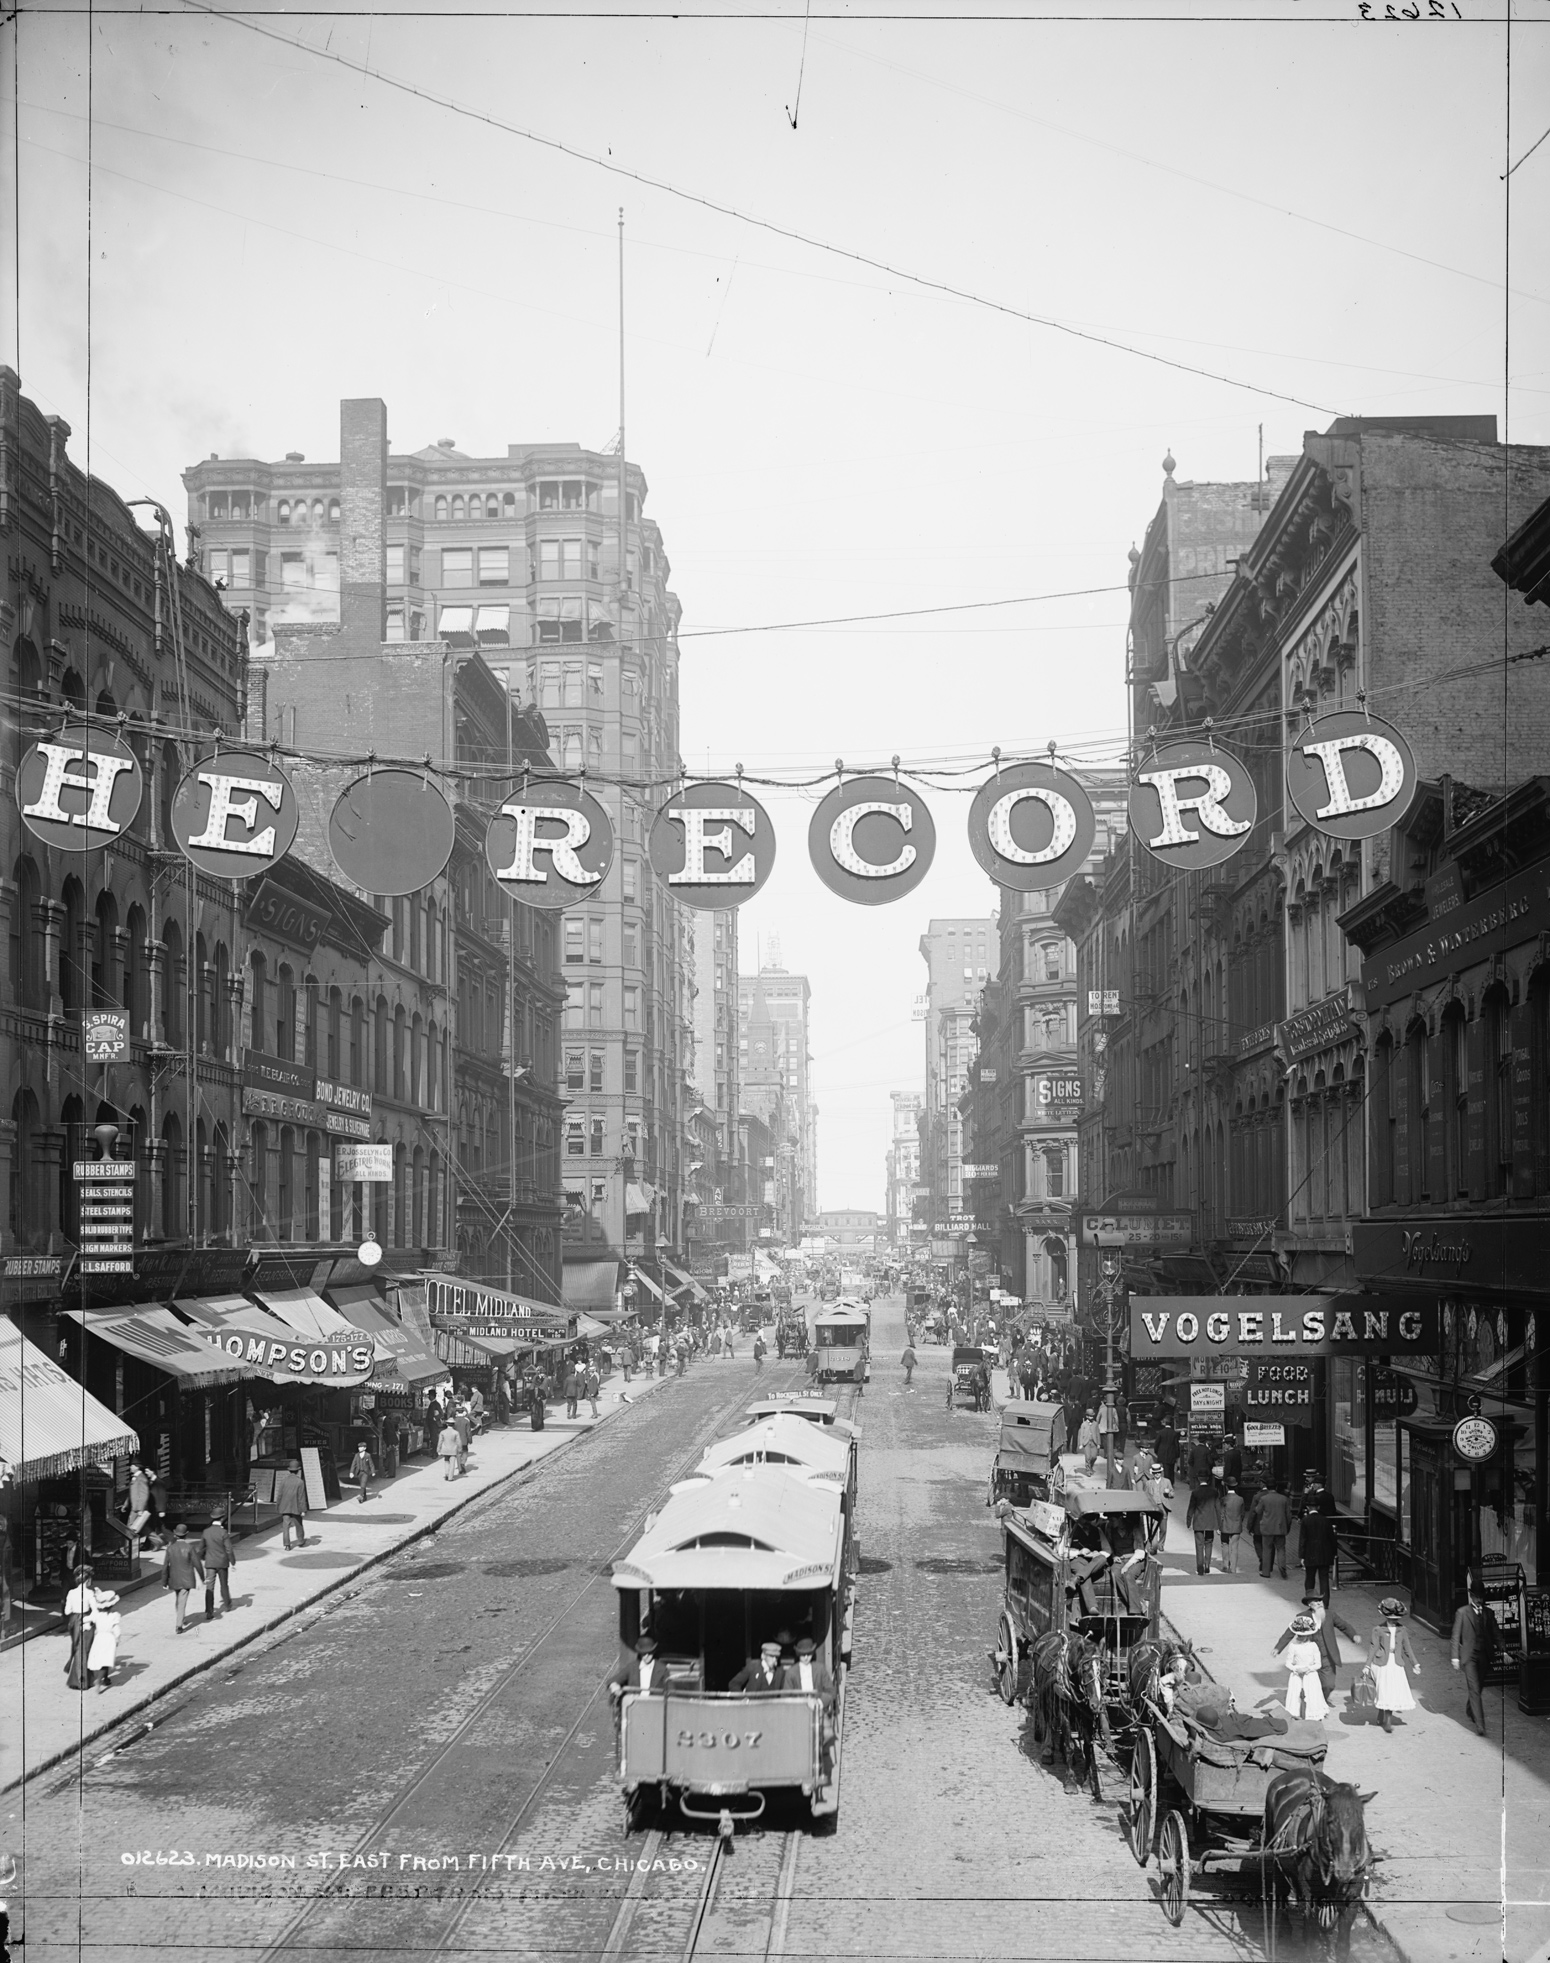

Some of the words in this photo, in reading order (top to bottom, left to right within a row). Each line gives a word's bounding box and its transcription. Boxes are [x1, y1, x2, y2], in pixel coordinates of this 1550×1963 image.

[1432, 894, 1461, 920] JEWELERS
[1386, 953, 1423, 985] BROWN
[1438, 896, 1530, 957] WINTERBERG
[92, 1013, 125, 1030] SPIRA
[85, 1041, 125, 1053] CAP
[1038, 1080, 1081, 1104] SIGNS
[75, 1164, 105, 1177] RUBBER
[107, 1164, 134, 1177] STAMPS
[103, 1188, 133, 1197] STENCILS
[81, 1206, 104, 1217] STEEL
[104, 1206, 131, 1217] STAMPS
[699, 1207, 760, 1217] BREVOORT
[97, 1225, 119, 1234] RUBBER
[119, 1225, 133, 1234] TYPE
[934, 1222, 970, 1231] BILLIARD
[971, 1222, 992, 1231] HALL
[80, 1243, 99, 1253] SIGN
[100, 1243, 133, 1253] MARKERS
[425, 1278, 471, 1317] OTEL
[476, 1292, 532, 1319] MIDLAND
[469, 1326, 508, 1337] MIDLAND
[510, 1328, 545, 1338] HOTEL
[1140, 1311, 1423, 1343] VOGELSANG
[331, 1331, 365, 1343] 175-177
[207, 1334, 372, 1374] HOMPSON'S
[1219, 1362, 1230, 1375] 10
[1257, 1365, 1309, 1381] FOOD
[1191, 1389, 1202, 1398] FREE
[1209, 1388, 1223, 1398] LUNCH
[1247, 1389, 1310, 1406] LUNCH
[380, 1396, 414, 1409] BOOKS
[677, 1730, 763, 1750] 2307
